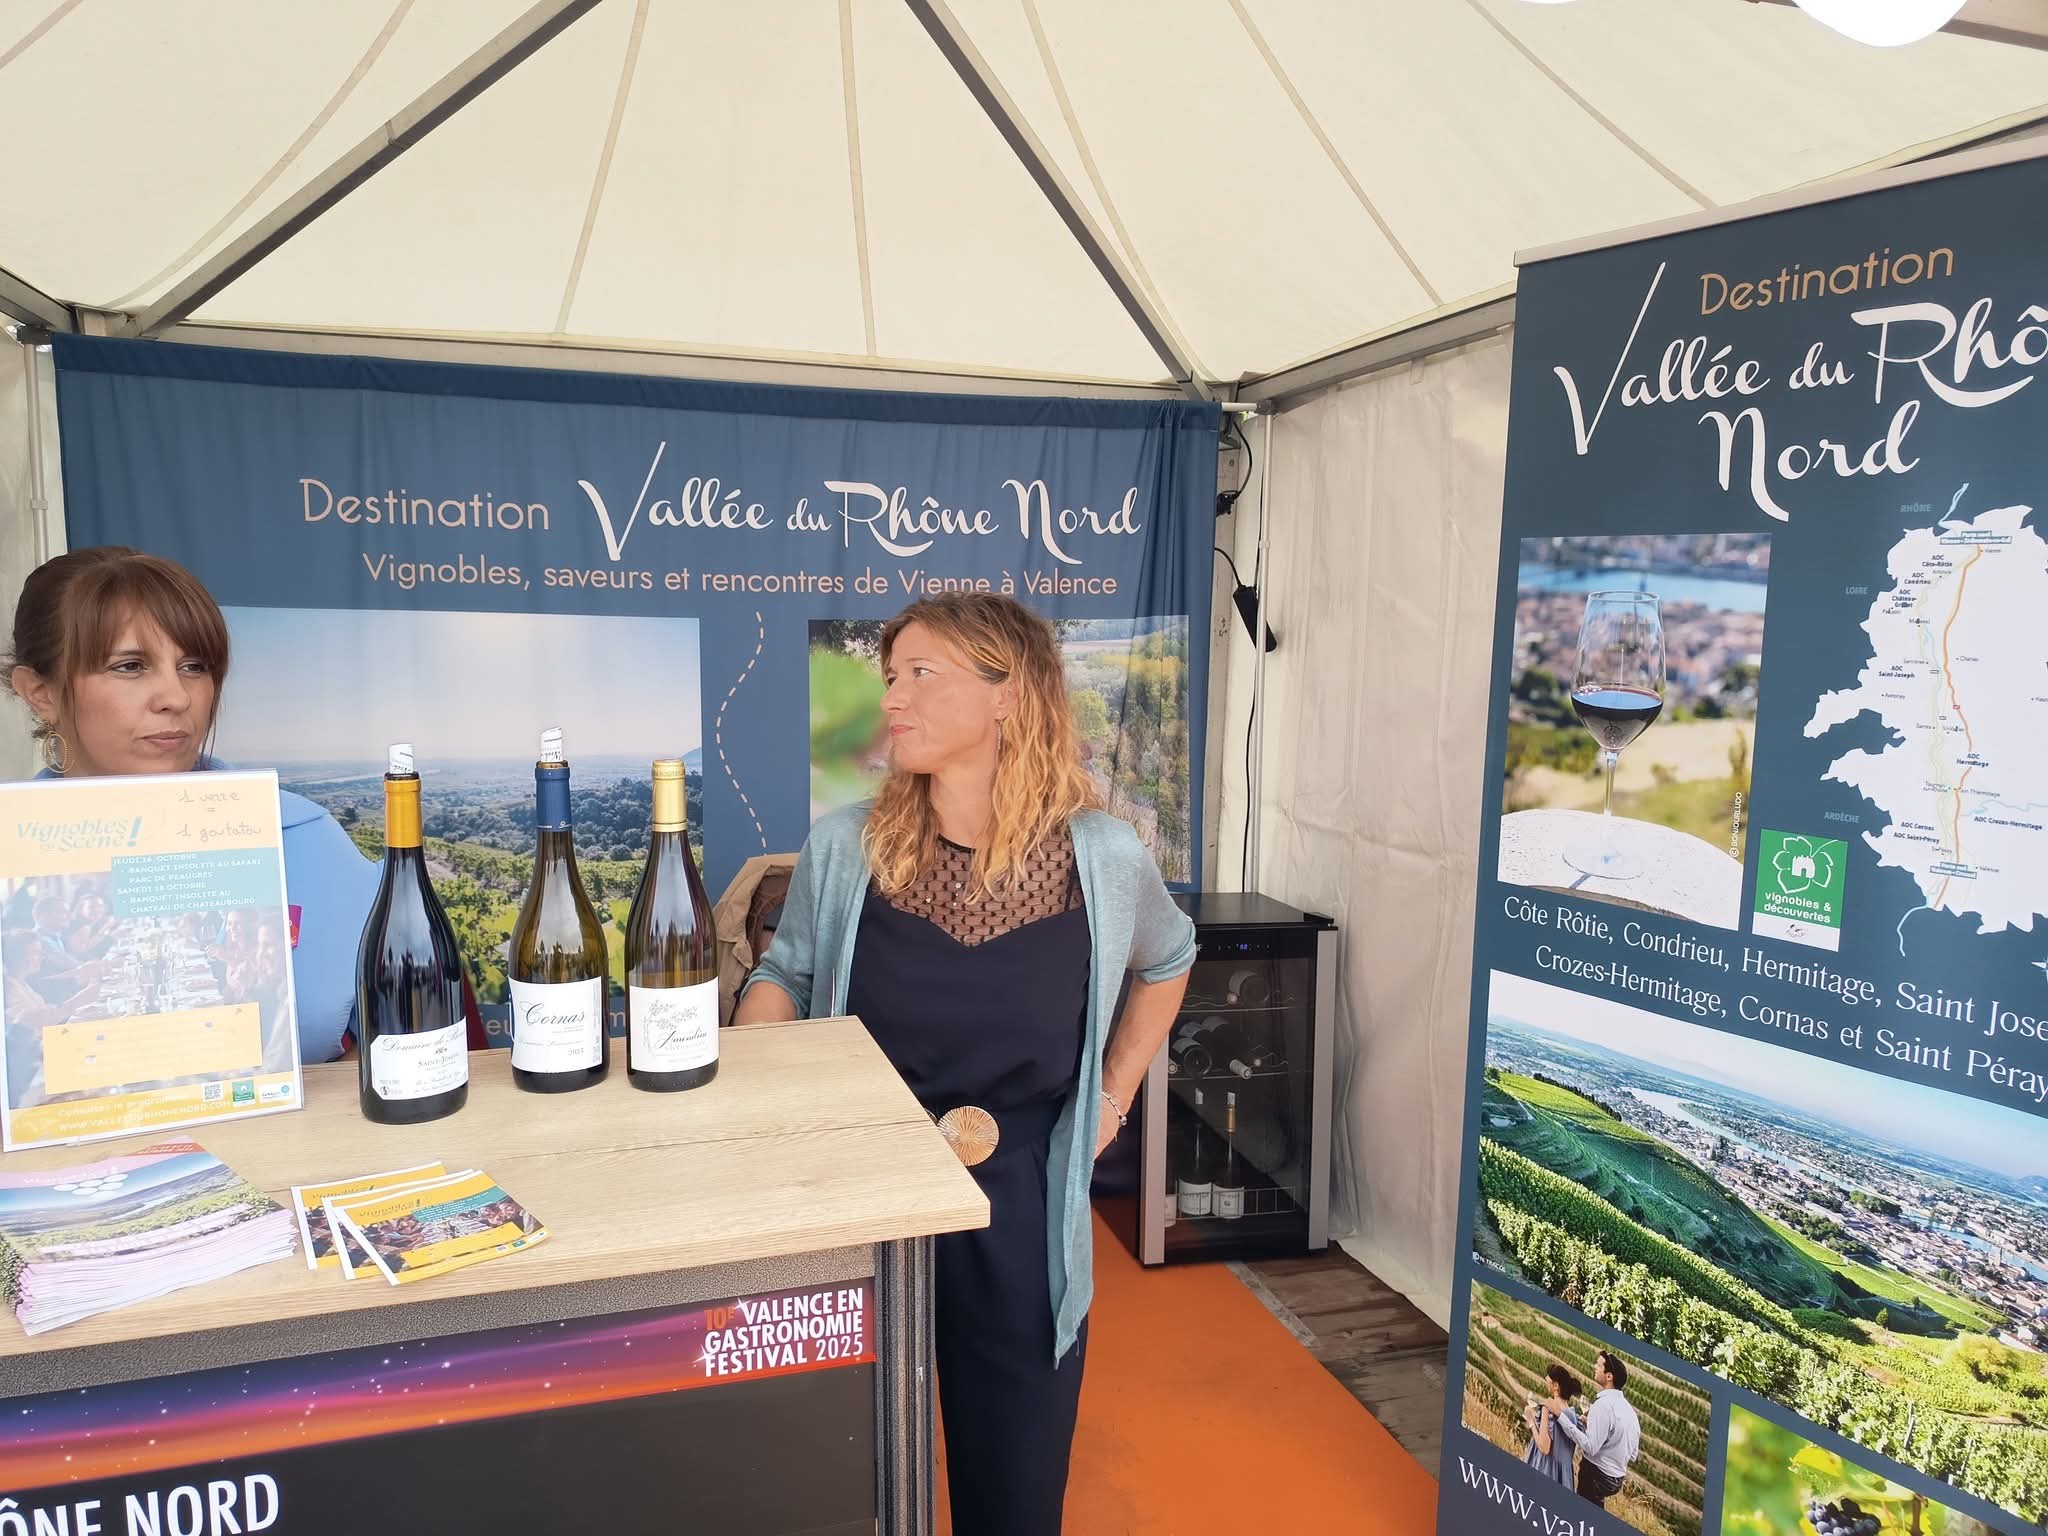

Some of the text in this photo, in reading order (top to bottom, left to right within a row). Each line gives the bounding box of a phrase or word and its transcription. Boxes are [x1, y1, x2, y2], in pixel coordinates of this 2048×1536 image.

[1700, 247, 1954, 316] Destination
[1553, 261, 1771, 456] Vallée
[1788, 341, 1856, 392] du
[1697, 399, 1921, 522] Nord
[299, 441, 1141, 565] Destination Vallée du Rhône Nord
[363, 552, 1118, 595] Vignobles, saveurs et rencontres de Vienne à Valence
[1845, 586, 1868, 595] LOIRE
[1764, 902, 1831, 923] découvertes
[1765, 892, 1832, 912] vignobles &
[1504, 896, 1548, 926] Côte
[1556, 906, 1614, 944] Rôtie,
[1623, 922, 1730, 972] Condrieu,
[1741, 948, 1881, 1008] Hermitage,
[1895, 981, 1976, 1023] Saint
[520, 1001, 585, 1026] Cornas
[1535, 945, 1727, 1018] Crozes-Hermitage,
[1739, 995, 1829, 1040] Cornas
[1840, 1024, 1864, 1049] et
[1874, 1028, 1952, 1071] Saint
[705, 1311, 863, 1354] GASTRONOMIE
[741, 1292, 833, 1325] VALENCE
[837, 1287, 863, 1312] EN
[705, 1333, 863, 1377] FESTIVAL 2025
[125, 1473, 279, 1536] NORD
[1458, 1456, 1595, 1536] www.va
